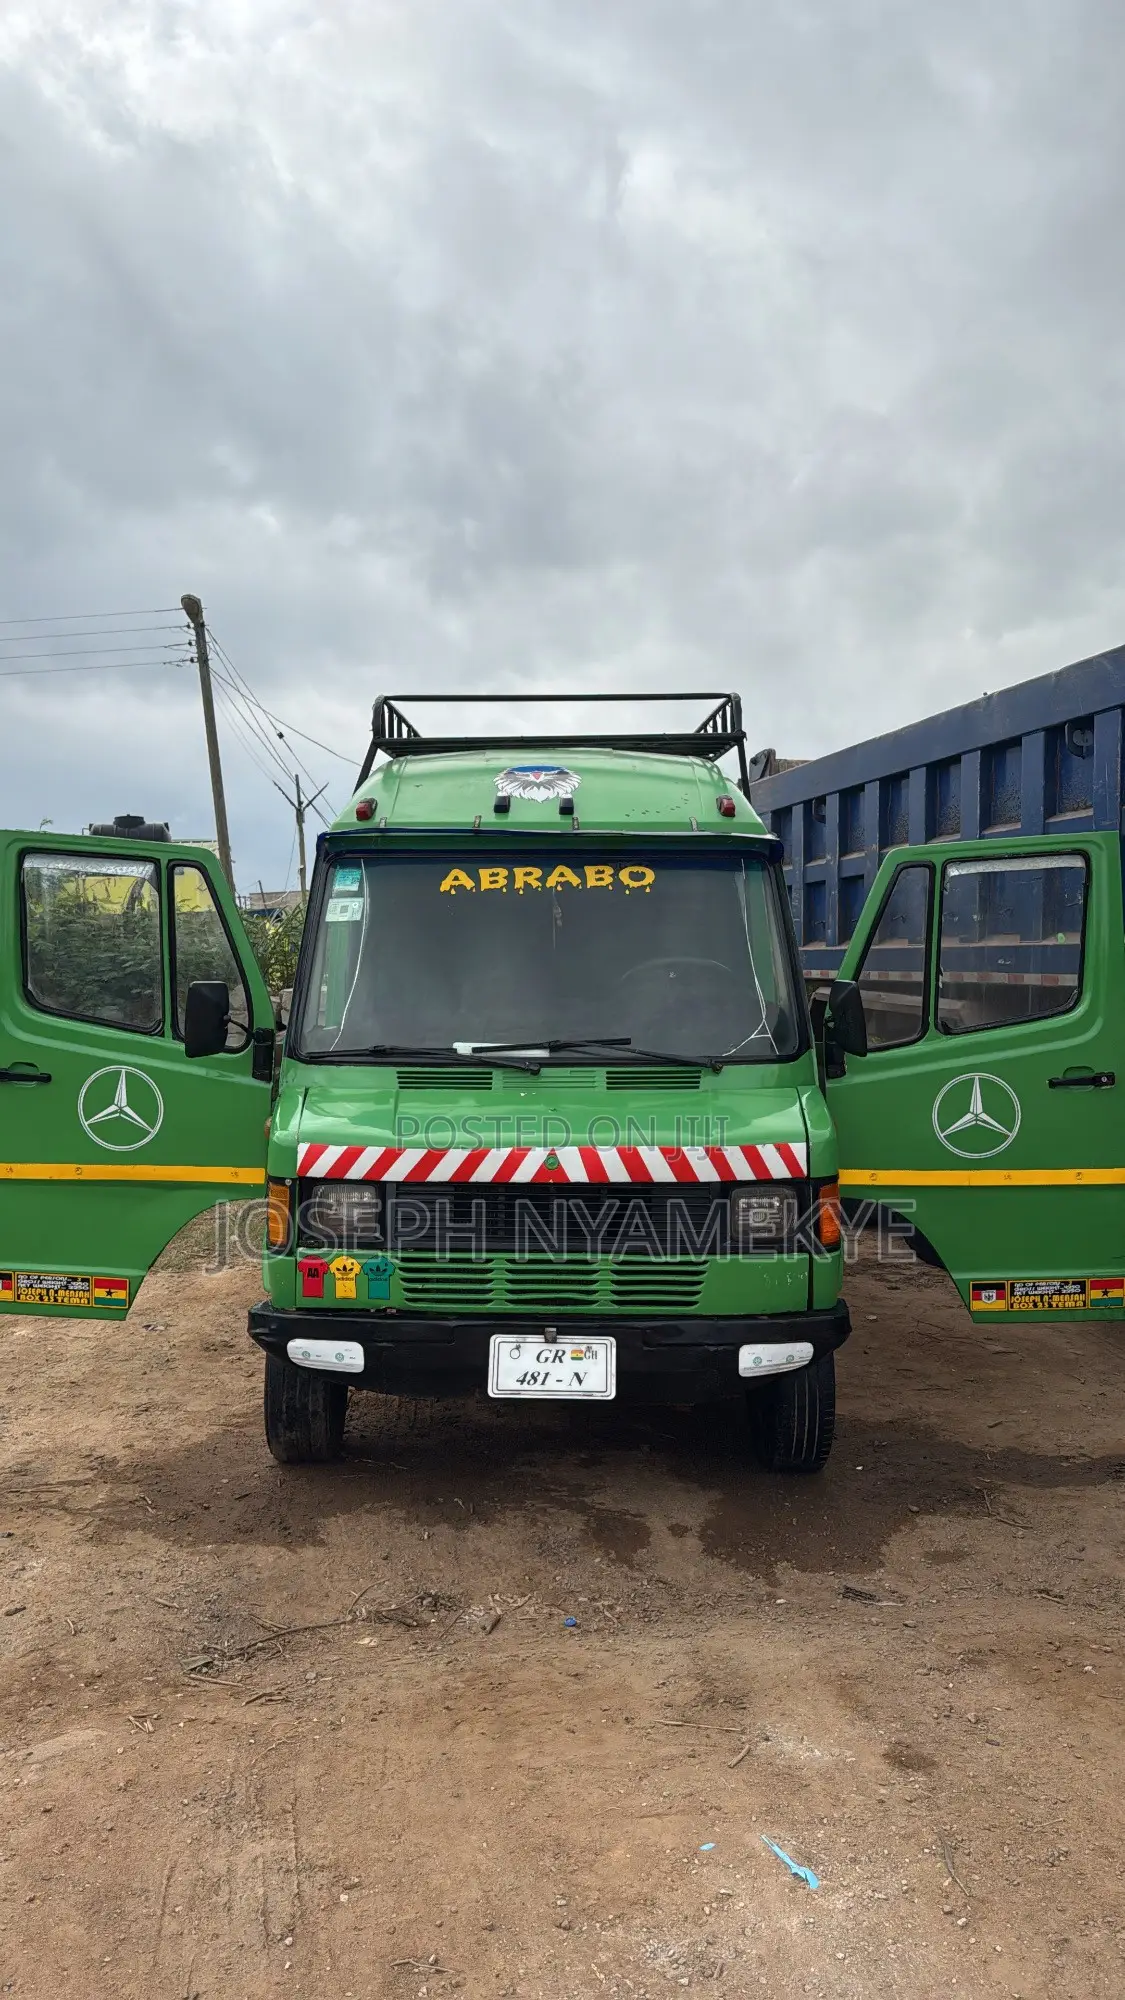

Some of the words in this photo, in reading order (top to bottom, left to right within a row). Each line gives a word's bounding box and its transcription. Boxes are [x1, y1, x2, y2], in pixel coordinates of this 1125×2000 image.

[439, 864, 656, 895] ABRABO
[18, 1287, 47, 1296] JOSEPH
[1011, 1295, 1040, 1303] JOSEPH
[536, 1348, 566, 1364] GR
[515, 1371, 551, 1386] 481
[568, 1372, 588, 1386] N
